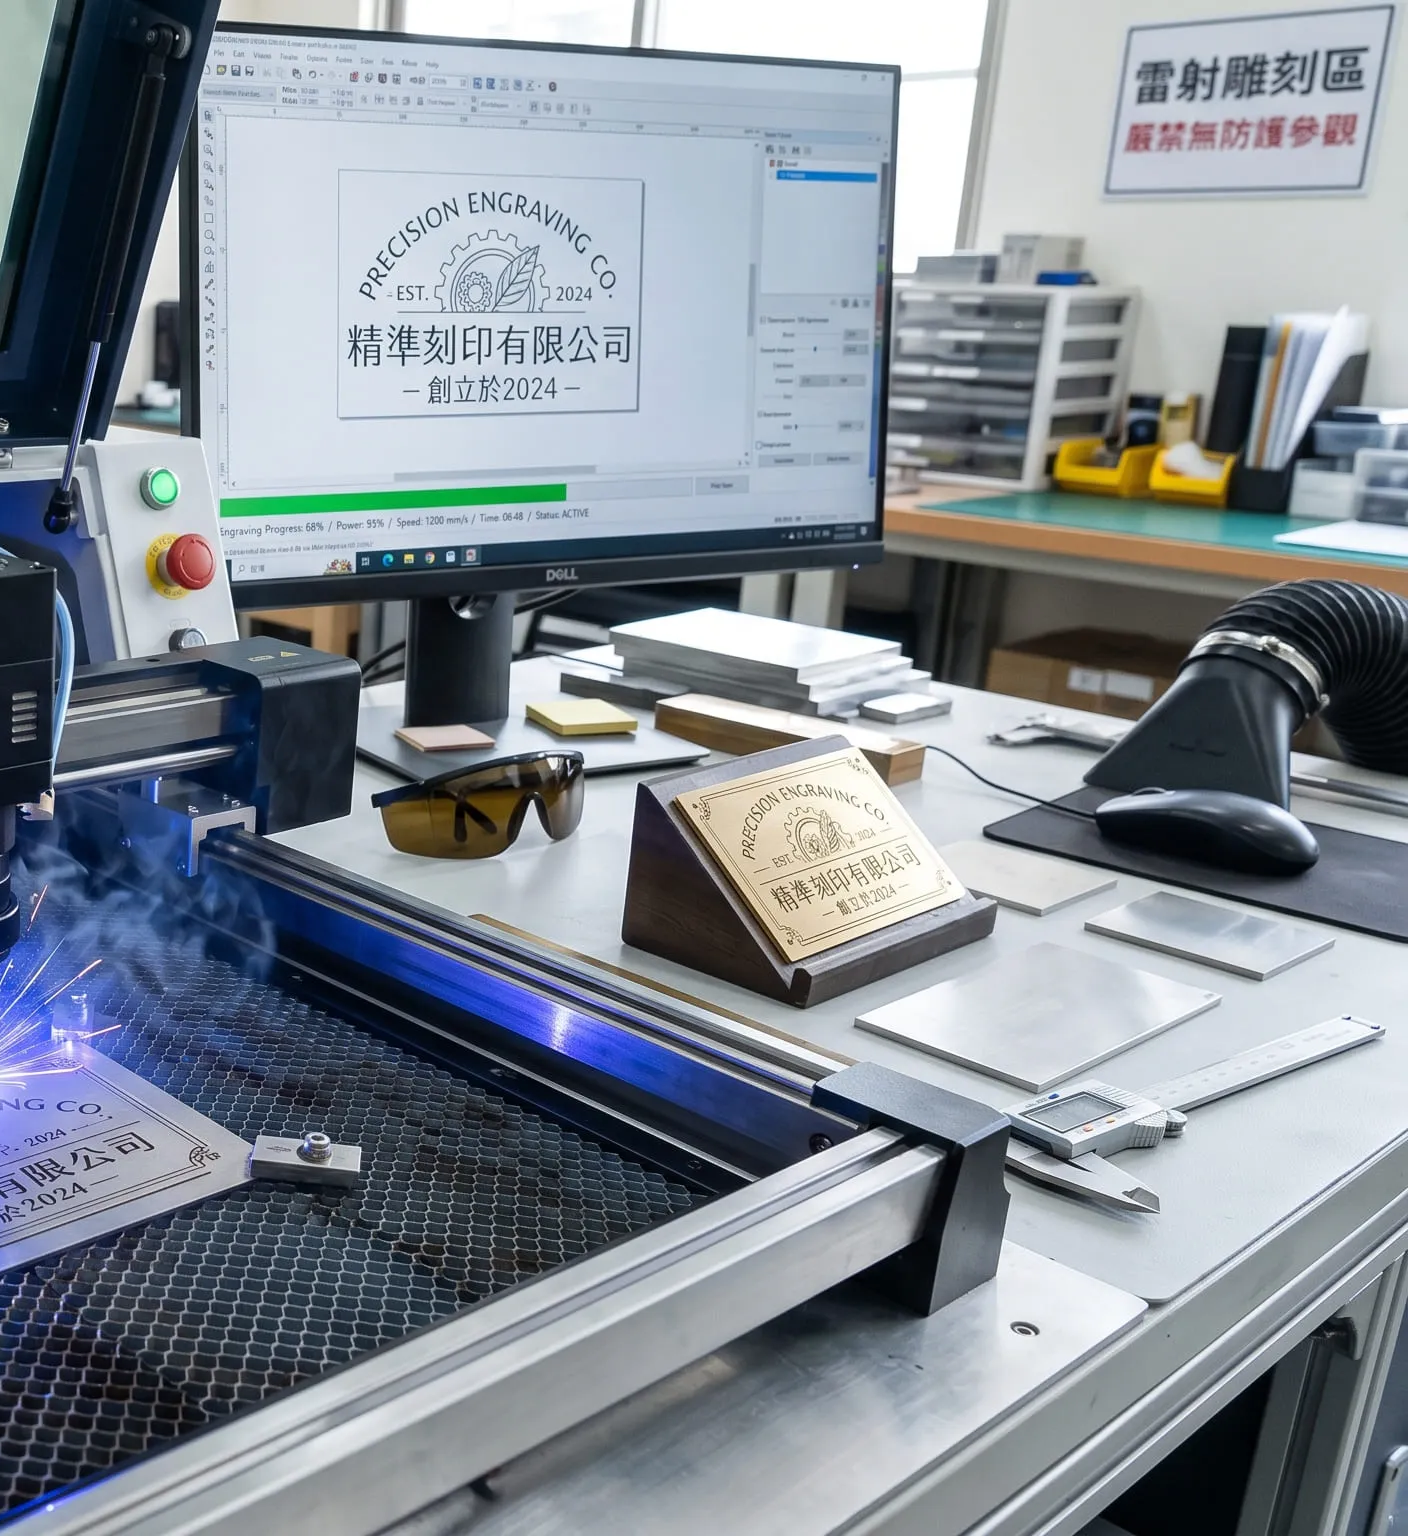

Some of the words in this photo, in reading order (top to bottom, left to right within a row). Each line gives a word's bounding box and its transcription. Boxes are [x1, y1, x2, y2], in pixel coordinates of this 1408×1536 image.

[1135, 46, 1370, 105] 雷射雕刻區
[359, 197, 460, 300] PRECISION
[467, 191, 592, 254] ENGRAVING
[590, 254, 617, 299] CO.
[396, 285, 429, 301] EST.
[555, 286, 593, 301] 2024
[347, 324, 631, 367] 精準刻印有限公司
[220, 527, 263, 538] Engraving
[265, 524, 303, 536] Progress:
[305, 522, 324, 532] 68%
[336, 520, 364, 530] Power:
[366, 519, 385, 529] 95%
[396, 517, 423, 529] Speed:
[425, 515, 445, 526] 1200
[446, 514, 469, 525] mm/s
[562, 508, 590, 519] ACTIVE
[545, 568, 579, 582] DELL
[742, 790, 781, 860] PRECISION
[778, 783, 861, 809] ENGRAVING
[770, 842, 922, 914] 精準刻印有限公司
[23, 1127, 68, 1147] 2024
